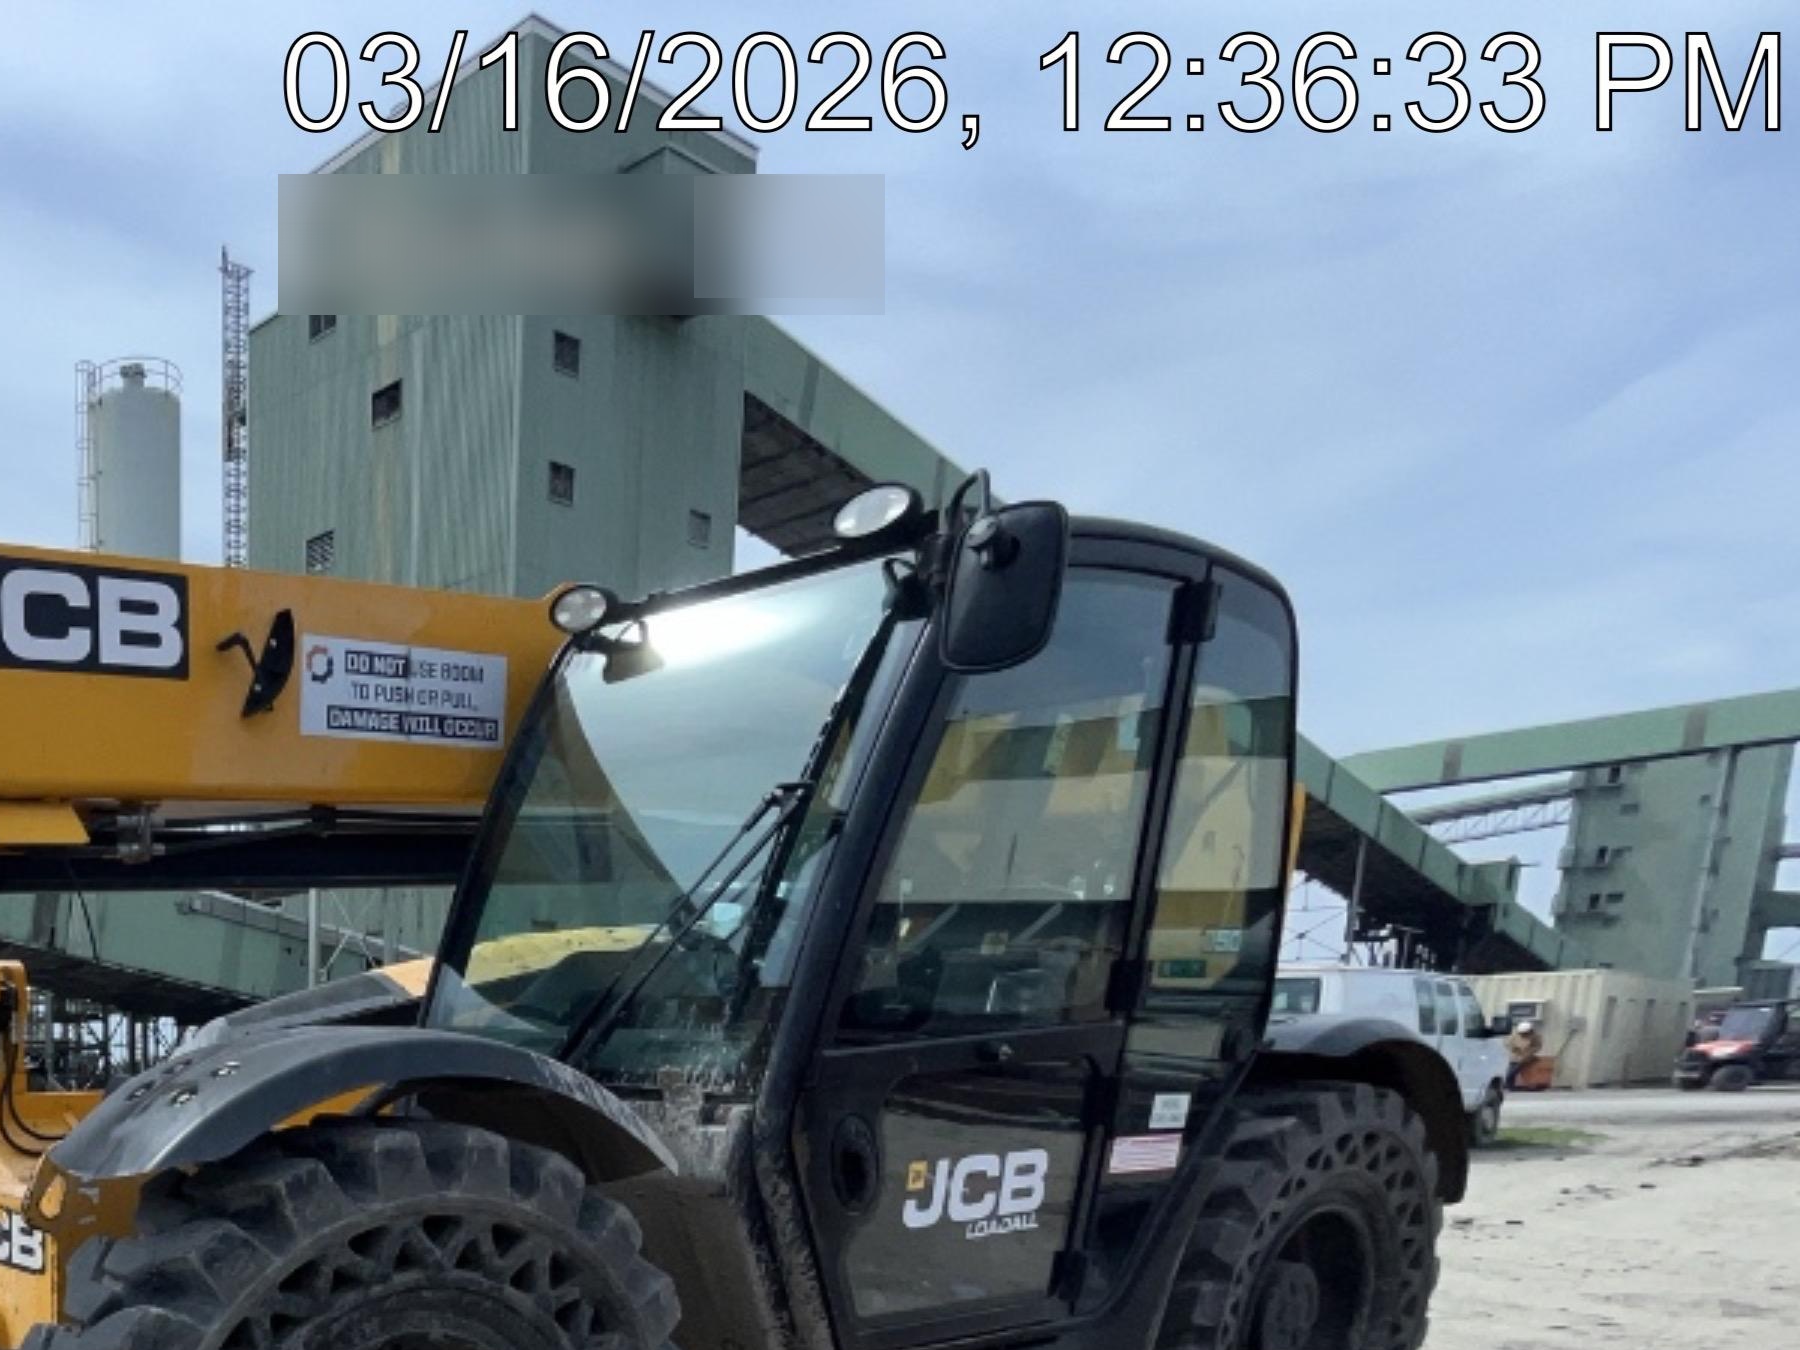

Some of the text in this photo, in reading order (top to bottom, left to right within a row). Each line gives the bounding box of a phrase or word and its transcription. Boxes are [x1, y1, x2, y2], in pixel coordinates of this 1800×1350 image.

[347, 653, 371, 672] DO
[373, 656, 406, 677] NOT
[351, 681, 370, 700] TO
[374, 684, 414, 704] PUSH
[329, 709, 401, 731] DAMAGE
[902, 1149, 1049, 1229] JCB
